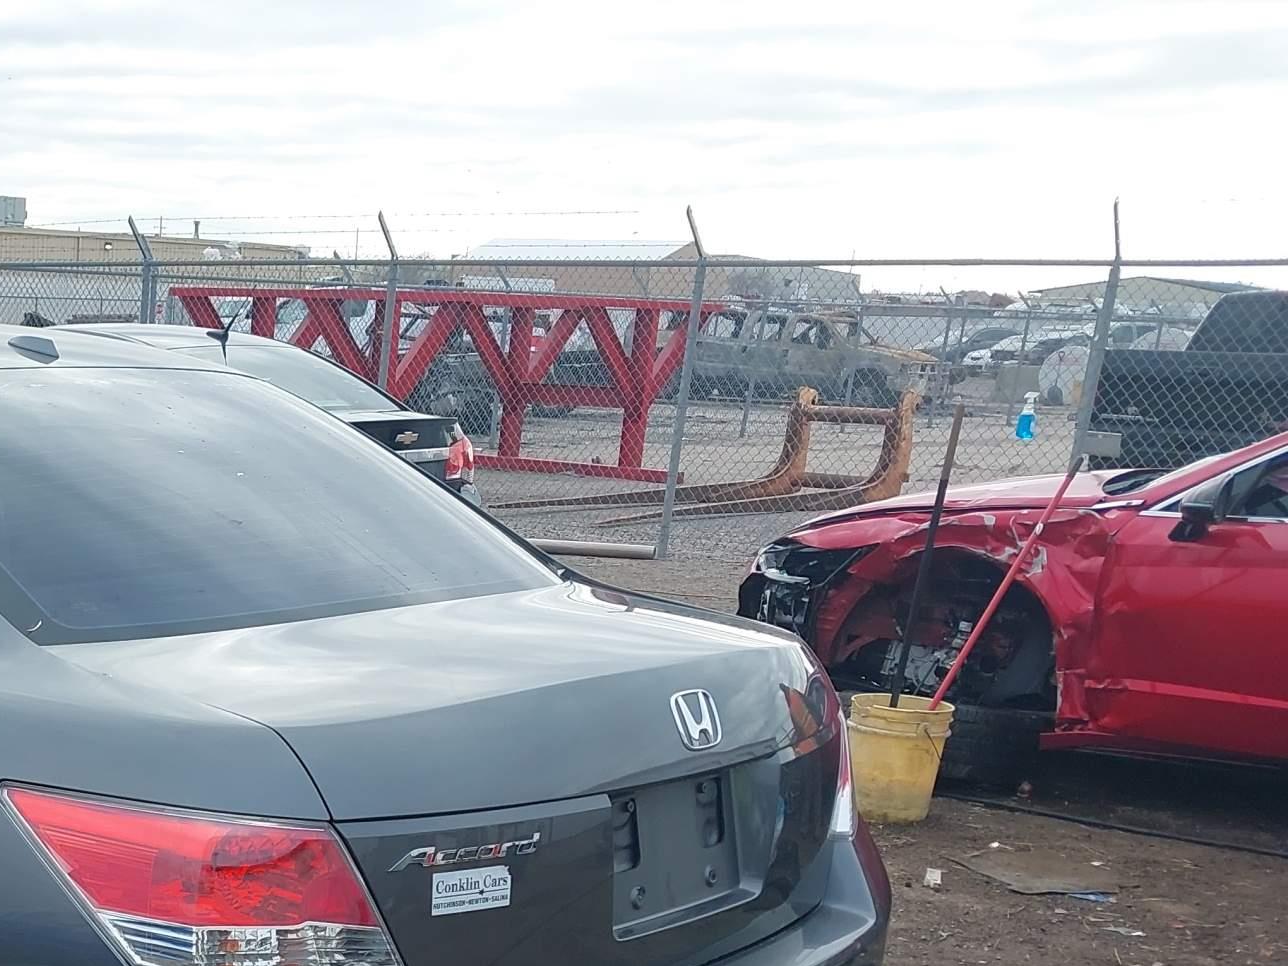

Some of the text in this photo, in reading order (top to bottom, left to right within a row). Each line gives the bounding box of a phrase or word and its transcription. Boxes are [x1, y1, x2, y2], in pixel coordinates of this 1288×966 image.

[387, 832, 541, 872] Accord
[435, 874, 508, 895] Conklin Cars
